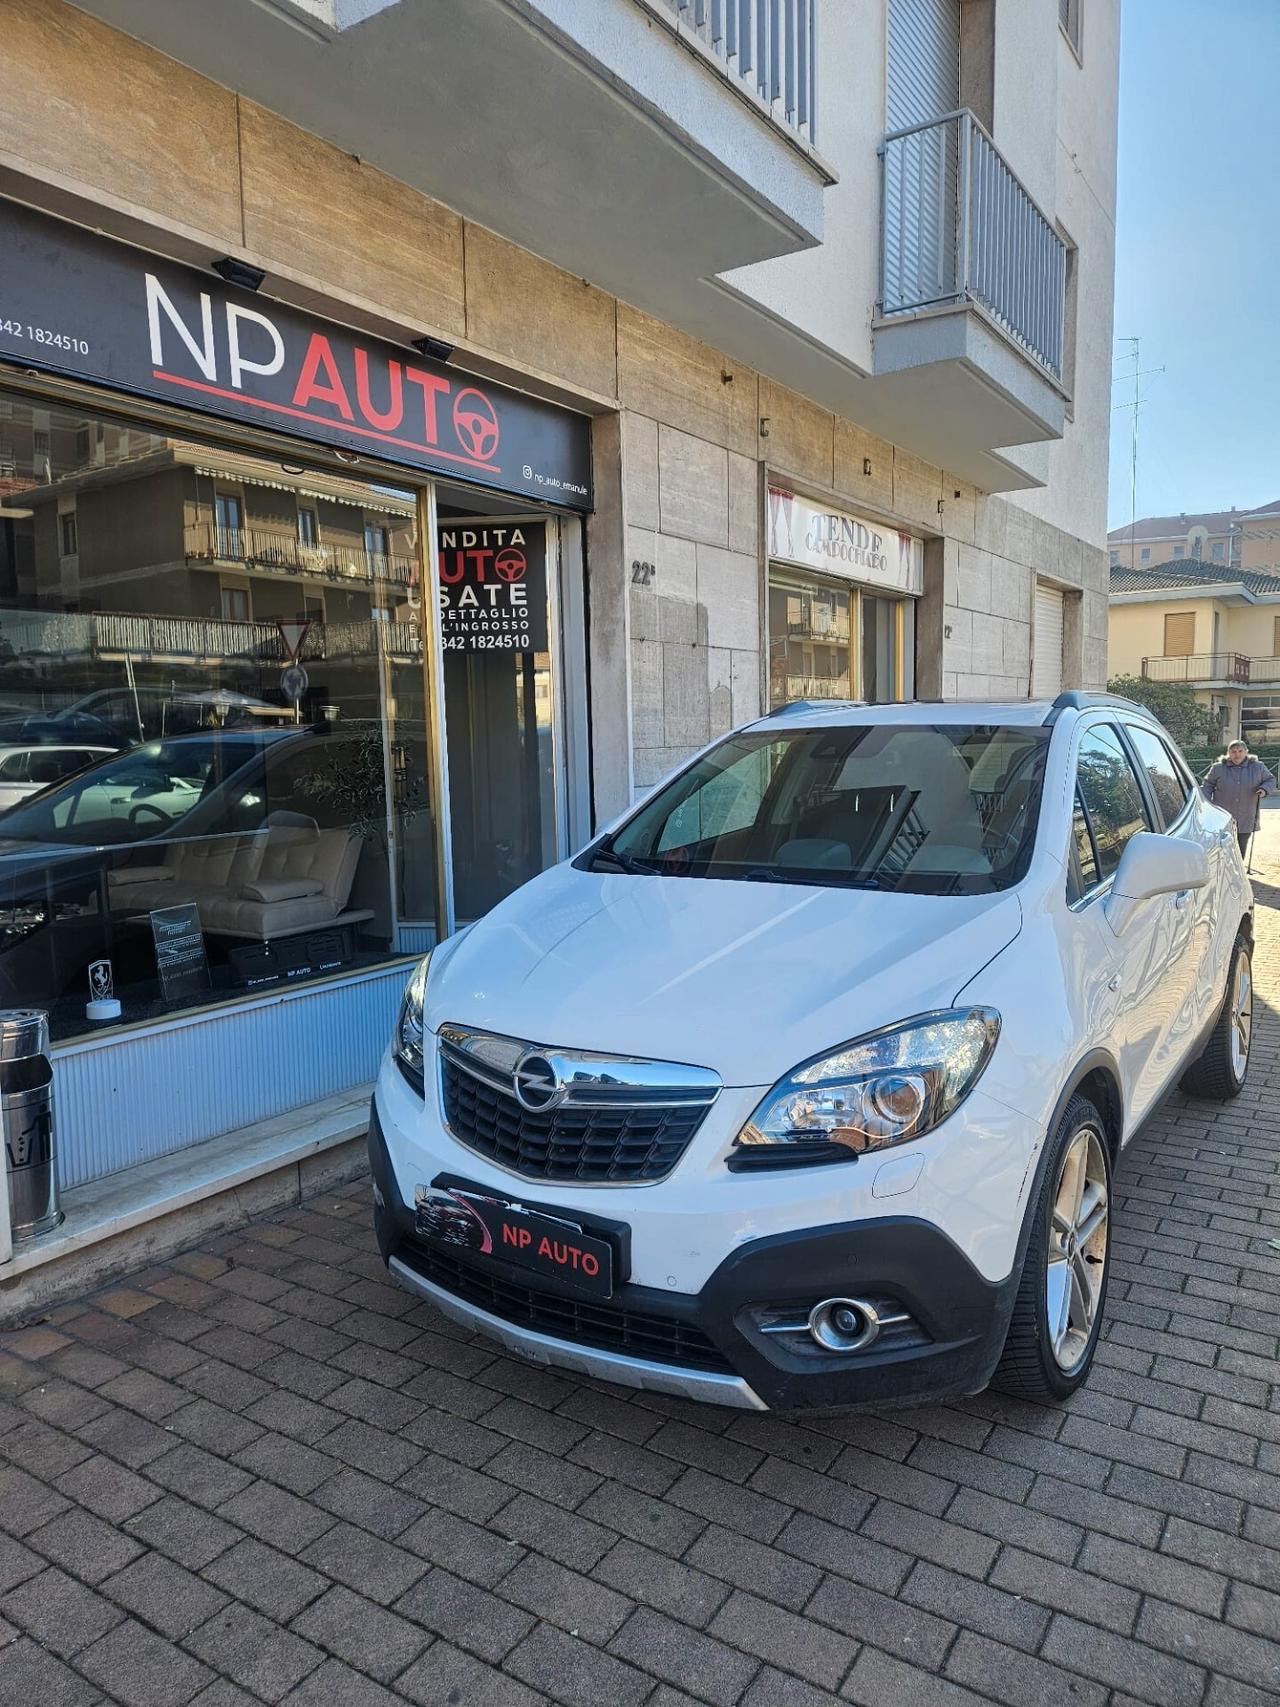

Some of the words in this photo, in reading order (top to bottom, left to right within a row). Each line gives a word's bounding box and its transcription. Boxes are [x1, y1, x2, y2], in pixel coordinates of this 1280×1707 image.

[27, 326, 89, 355] 1824510
[405, 529, 526, 549] VNDITA
[470, 634, 530, 649] 1824510
[503, 1223, 532, 1249] NP
[538, 1236, 600, 1276] AUTO
